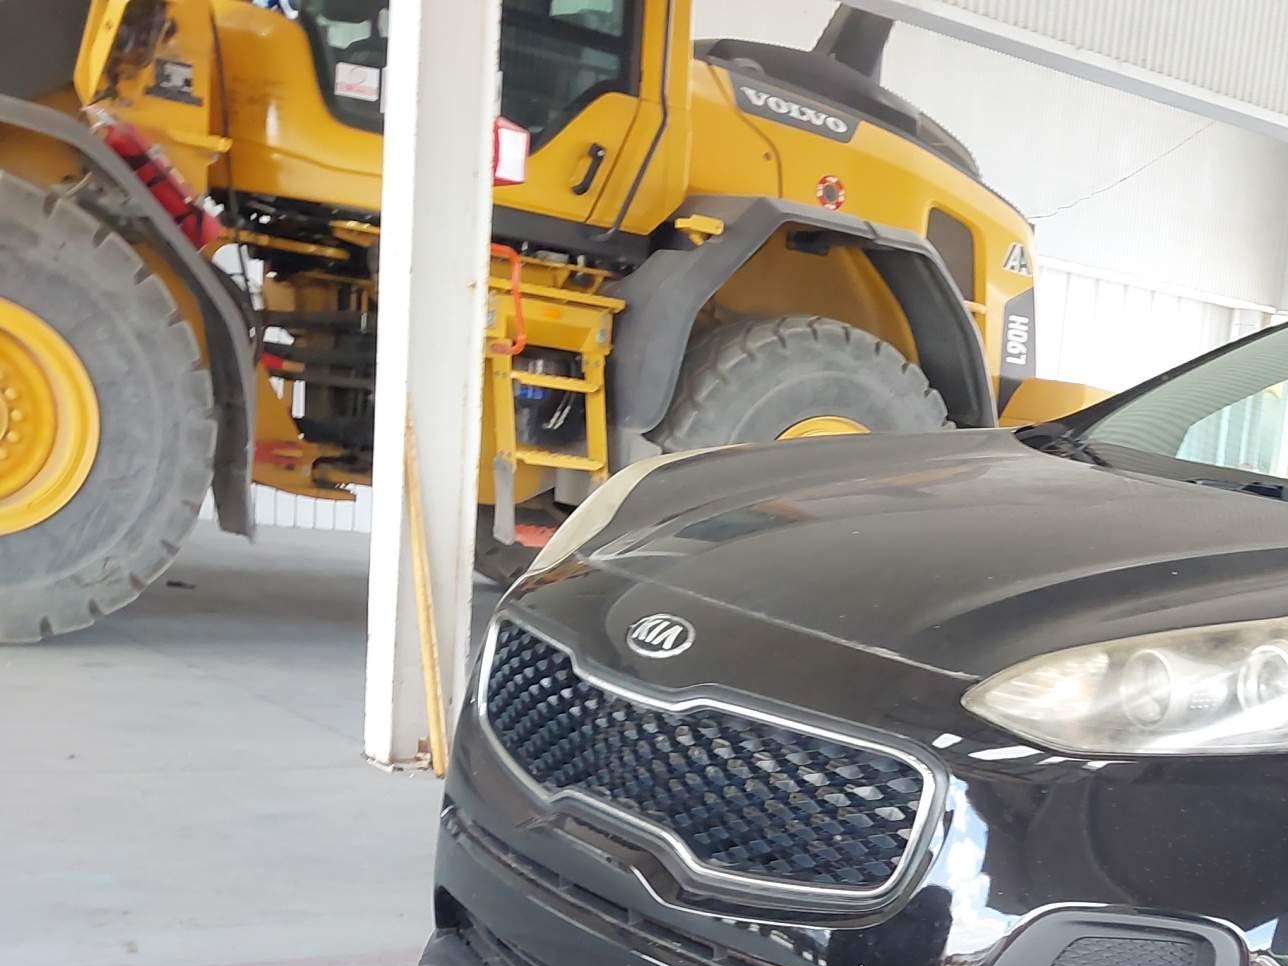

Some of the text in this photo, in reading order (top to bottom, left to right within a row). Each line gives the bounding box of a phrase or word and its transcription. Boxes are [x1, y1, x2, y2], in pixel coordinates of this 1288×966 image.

[740, 86, 848, 133] VOLVO
[1005, 314, 1029, 366] L90H
[631, 619, 684, 650] KIA
